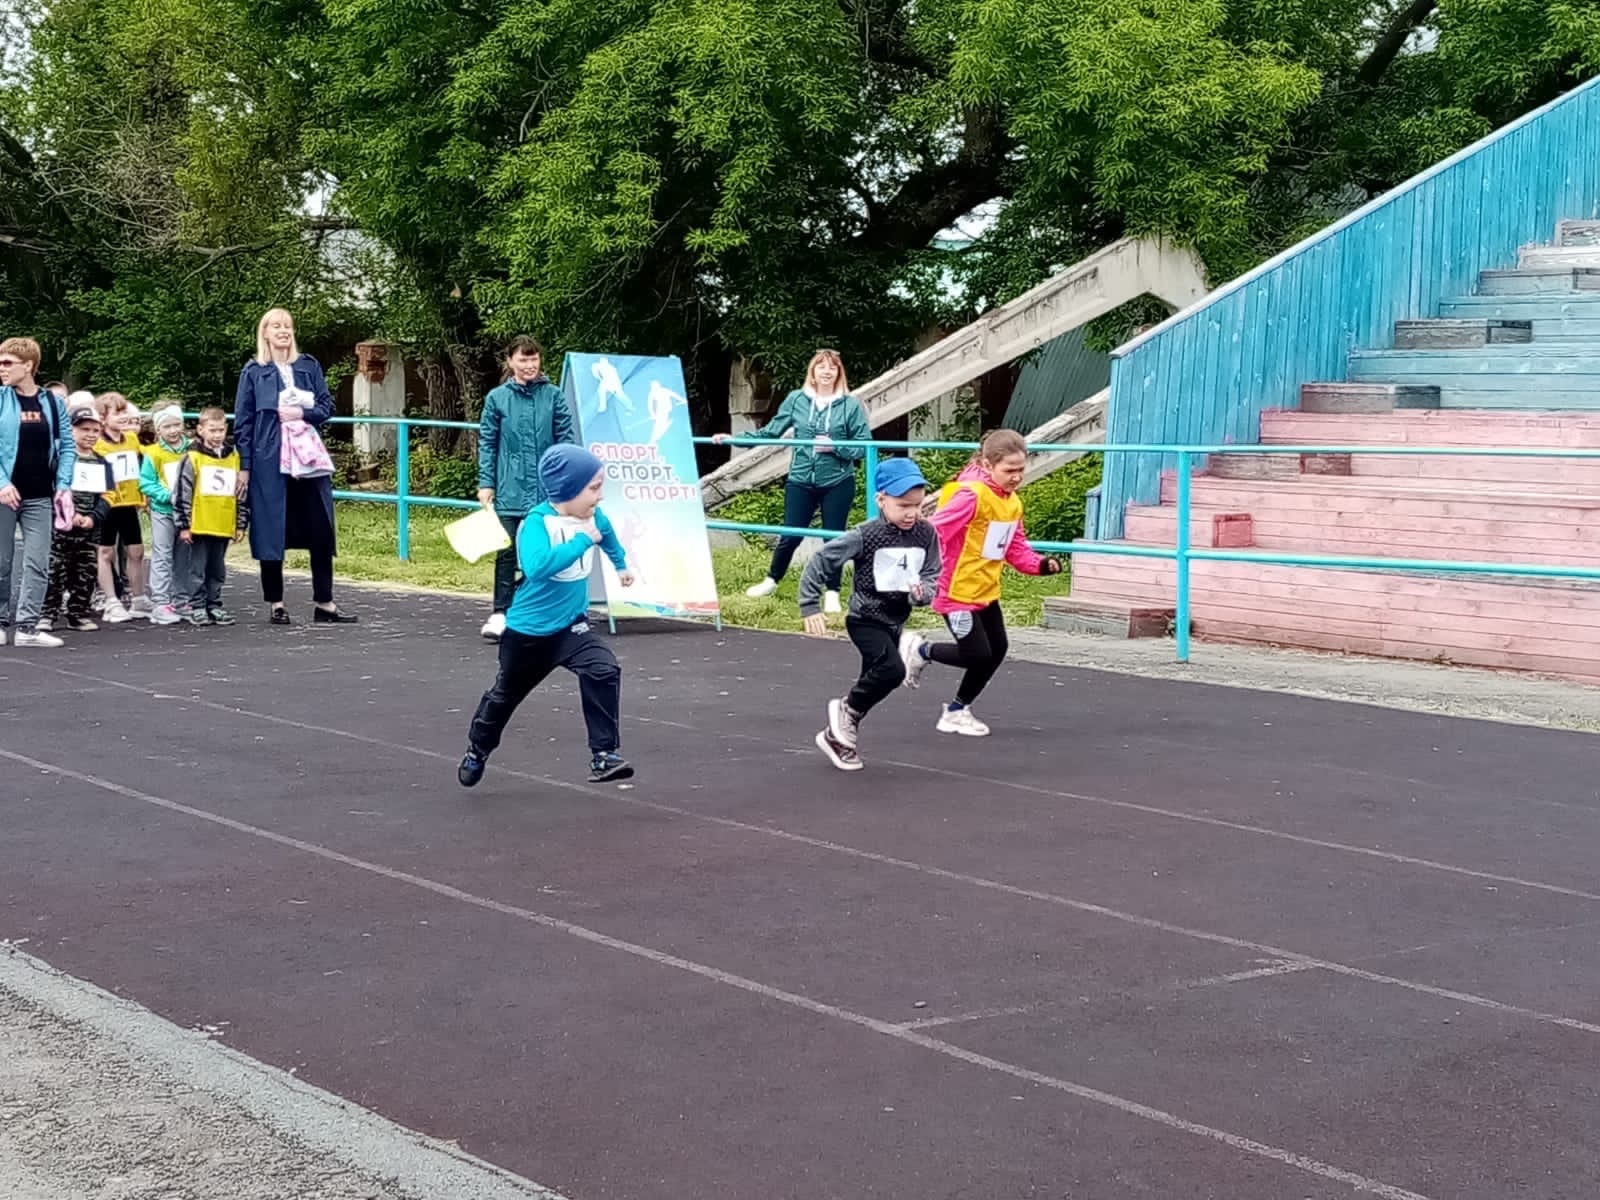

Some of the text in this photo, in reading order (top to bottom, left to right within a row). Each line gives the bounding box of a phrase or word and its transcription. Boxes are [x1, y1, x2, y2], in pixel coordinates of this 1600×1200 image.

[117, 454, 128, 476] 7
[211, 469, 226, 491] 5
[624, 485, 696, 500] СПОРТ!
[996, 523, 1012, 554] 4
[896, 553, 909, 571] 4
